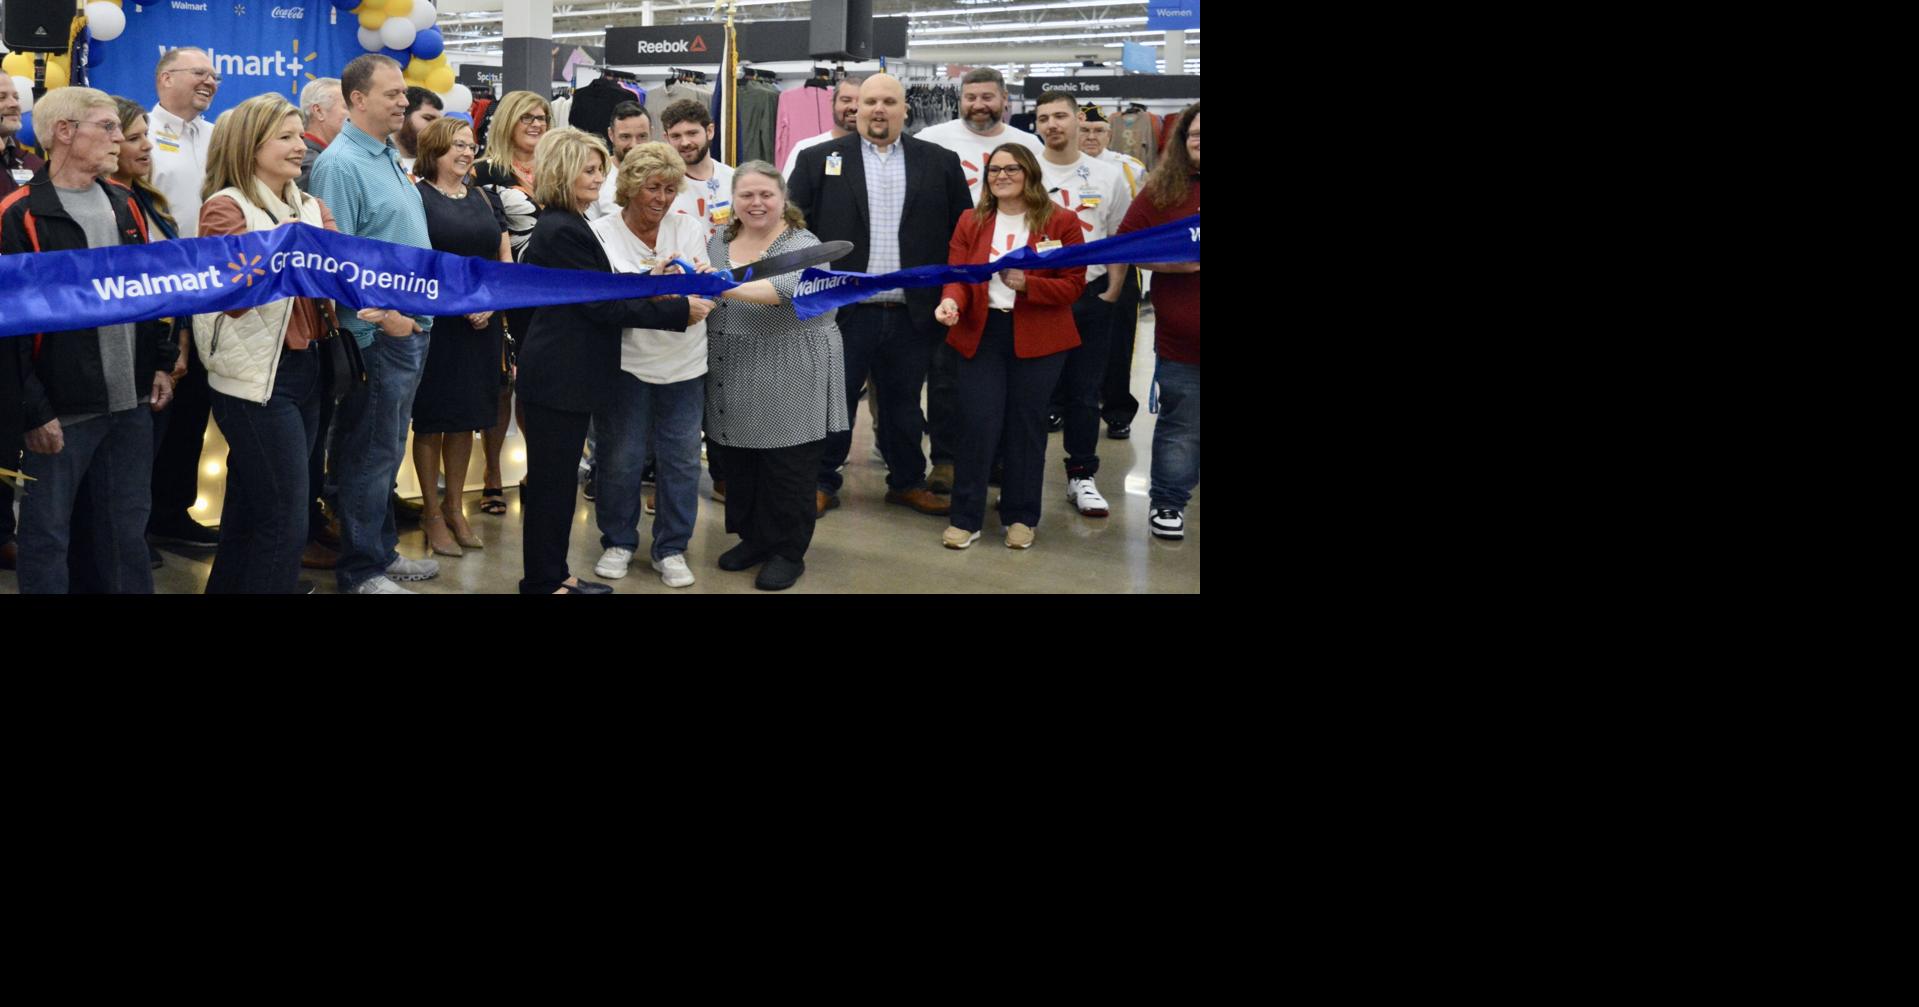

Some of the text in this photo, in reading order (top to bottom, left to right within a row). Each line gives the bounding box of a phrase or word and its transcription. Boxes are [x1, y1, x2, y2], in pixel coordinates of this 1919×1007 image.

[171, 1, 207, 12] Walmart
[1156, 8, 1192, 17] Women
[637, 39, 689, 54] Reebok
[1079, 82, 1100, 92] Tees
[92, 265, 223, 301] Walmart
